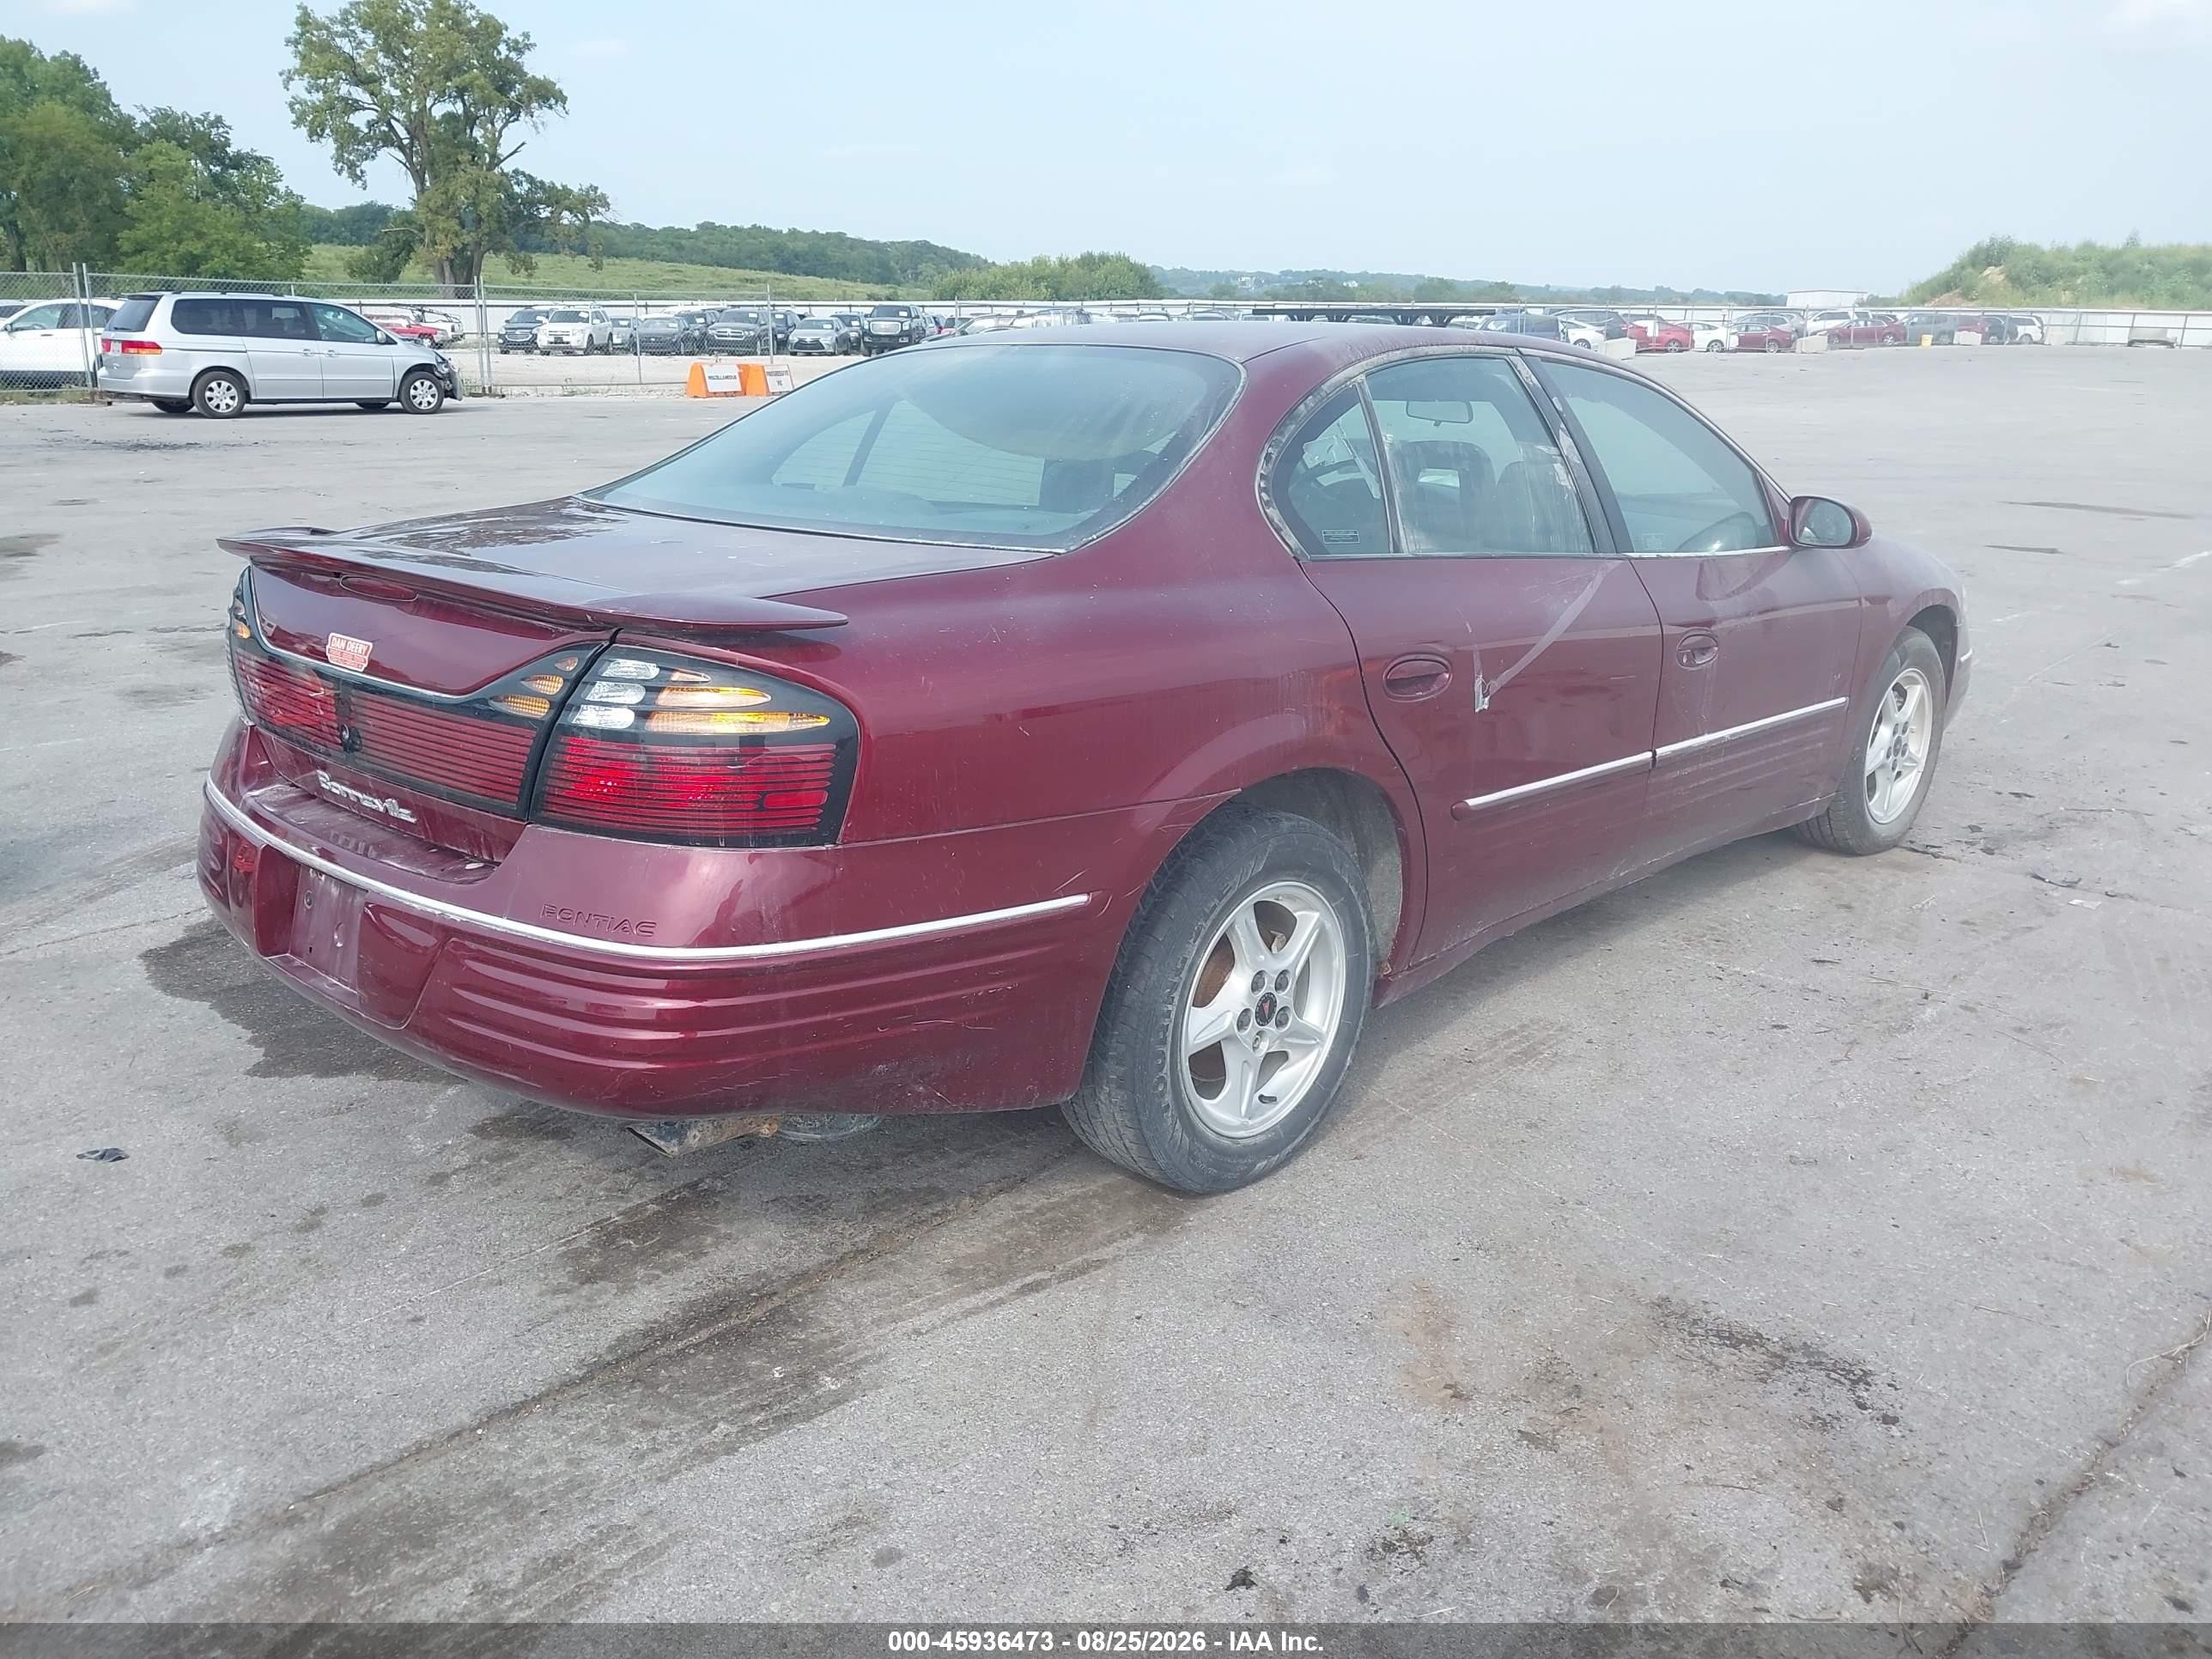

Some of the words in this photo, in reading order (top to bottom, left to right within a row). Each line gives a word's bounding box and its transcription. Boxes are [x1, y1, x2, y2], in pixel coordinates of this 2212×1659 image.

[331, 636, 347, 650] DAN
[345, 641, 368, 655] DEERY
[539, 903, 658, 938] PONTIAC
